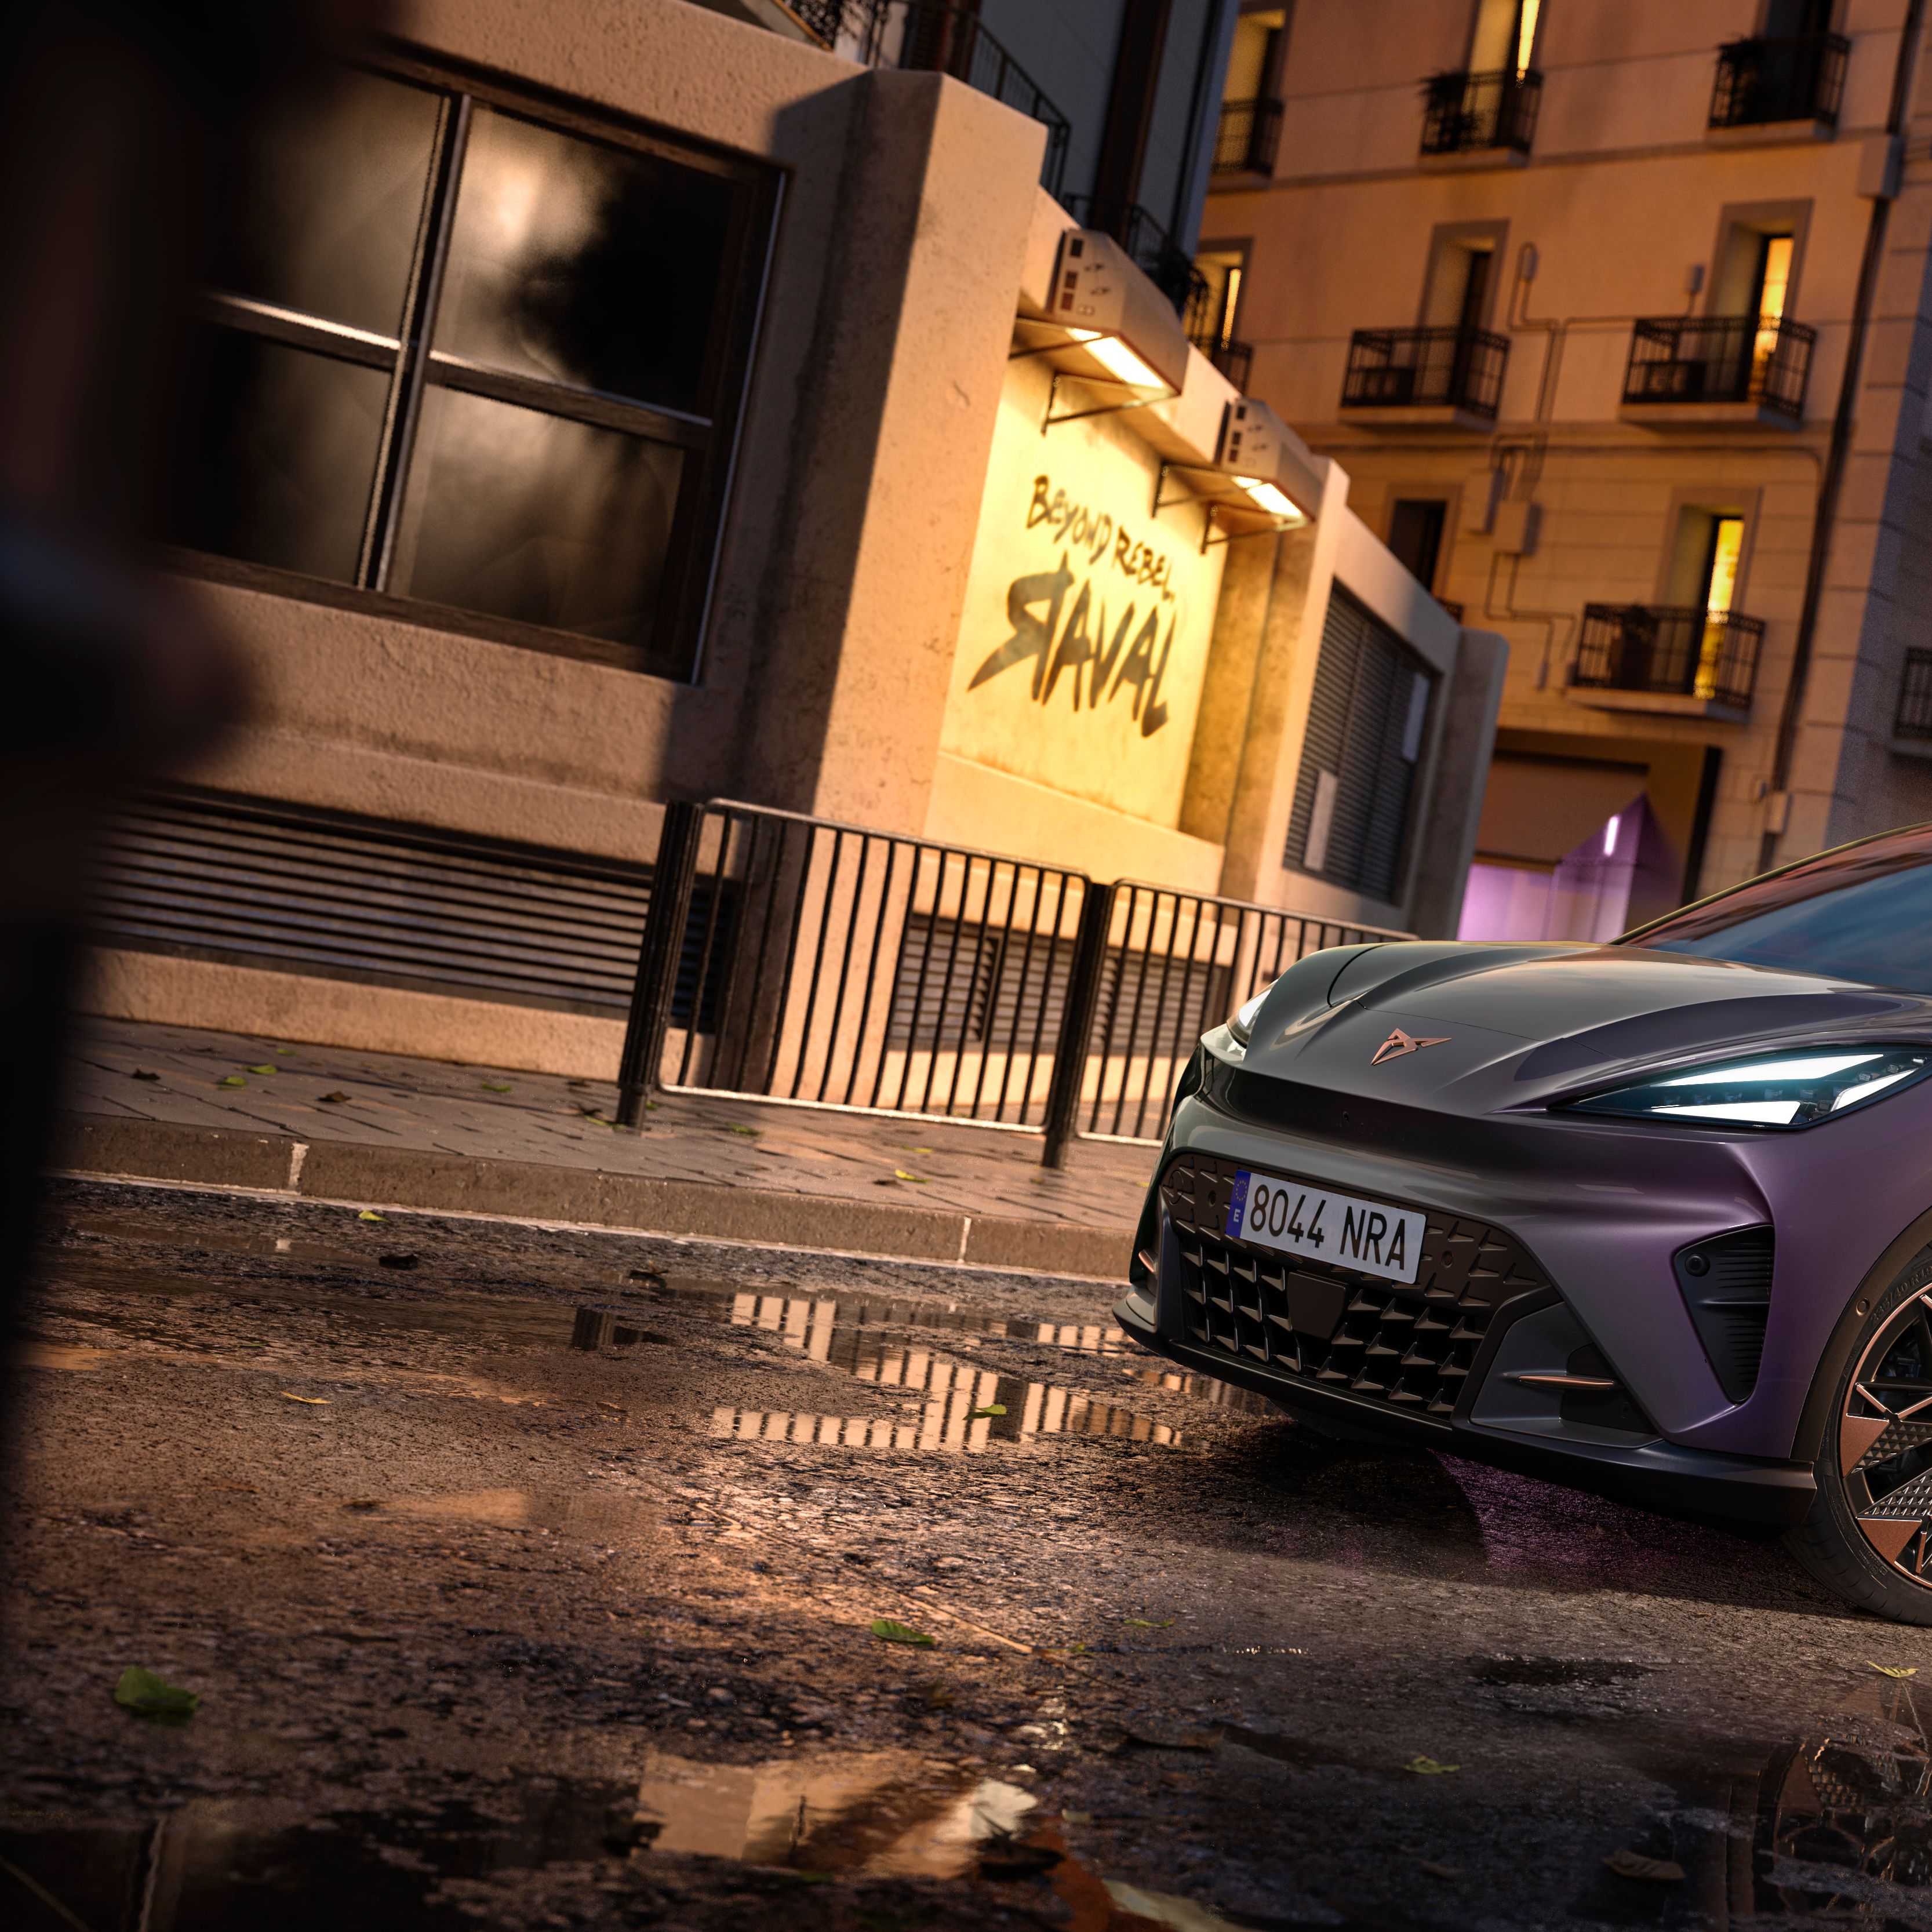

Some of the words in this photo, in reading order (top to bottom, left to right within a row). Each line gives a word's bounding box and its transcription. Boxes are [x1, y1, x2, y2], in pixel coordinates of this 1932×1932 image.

[1026, 475, 1112, 565] BEYOND
[1111, 526, 1176, 603] REBEL
[1233, 1208, 1241, 1222] E
[1250, 1184, 1327, 1249] 8044
[1339, 1206, 1406, 1271] NRA
